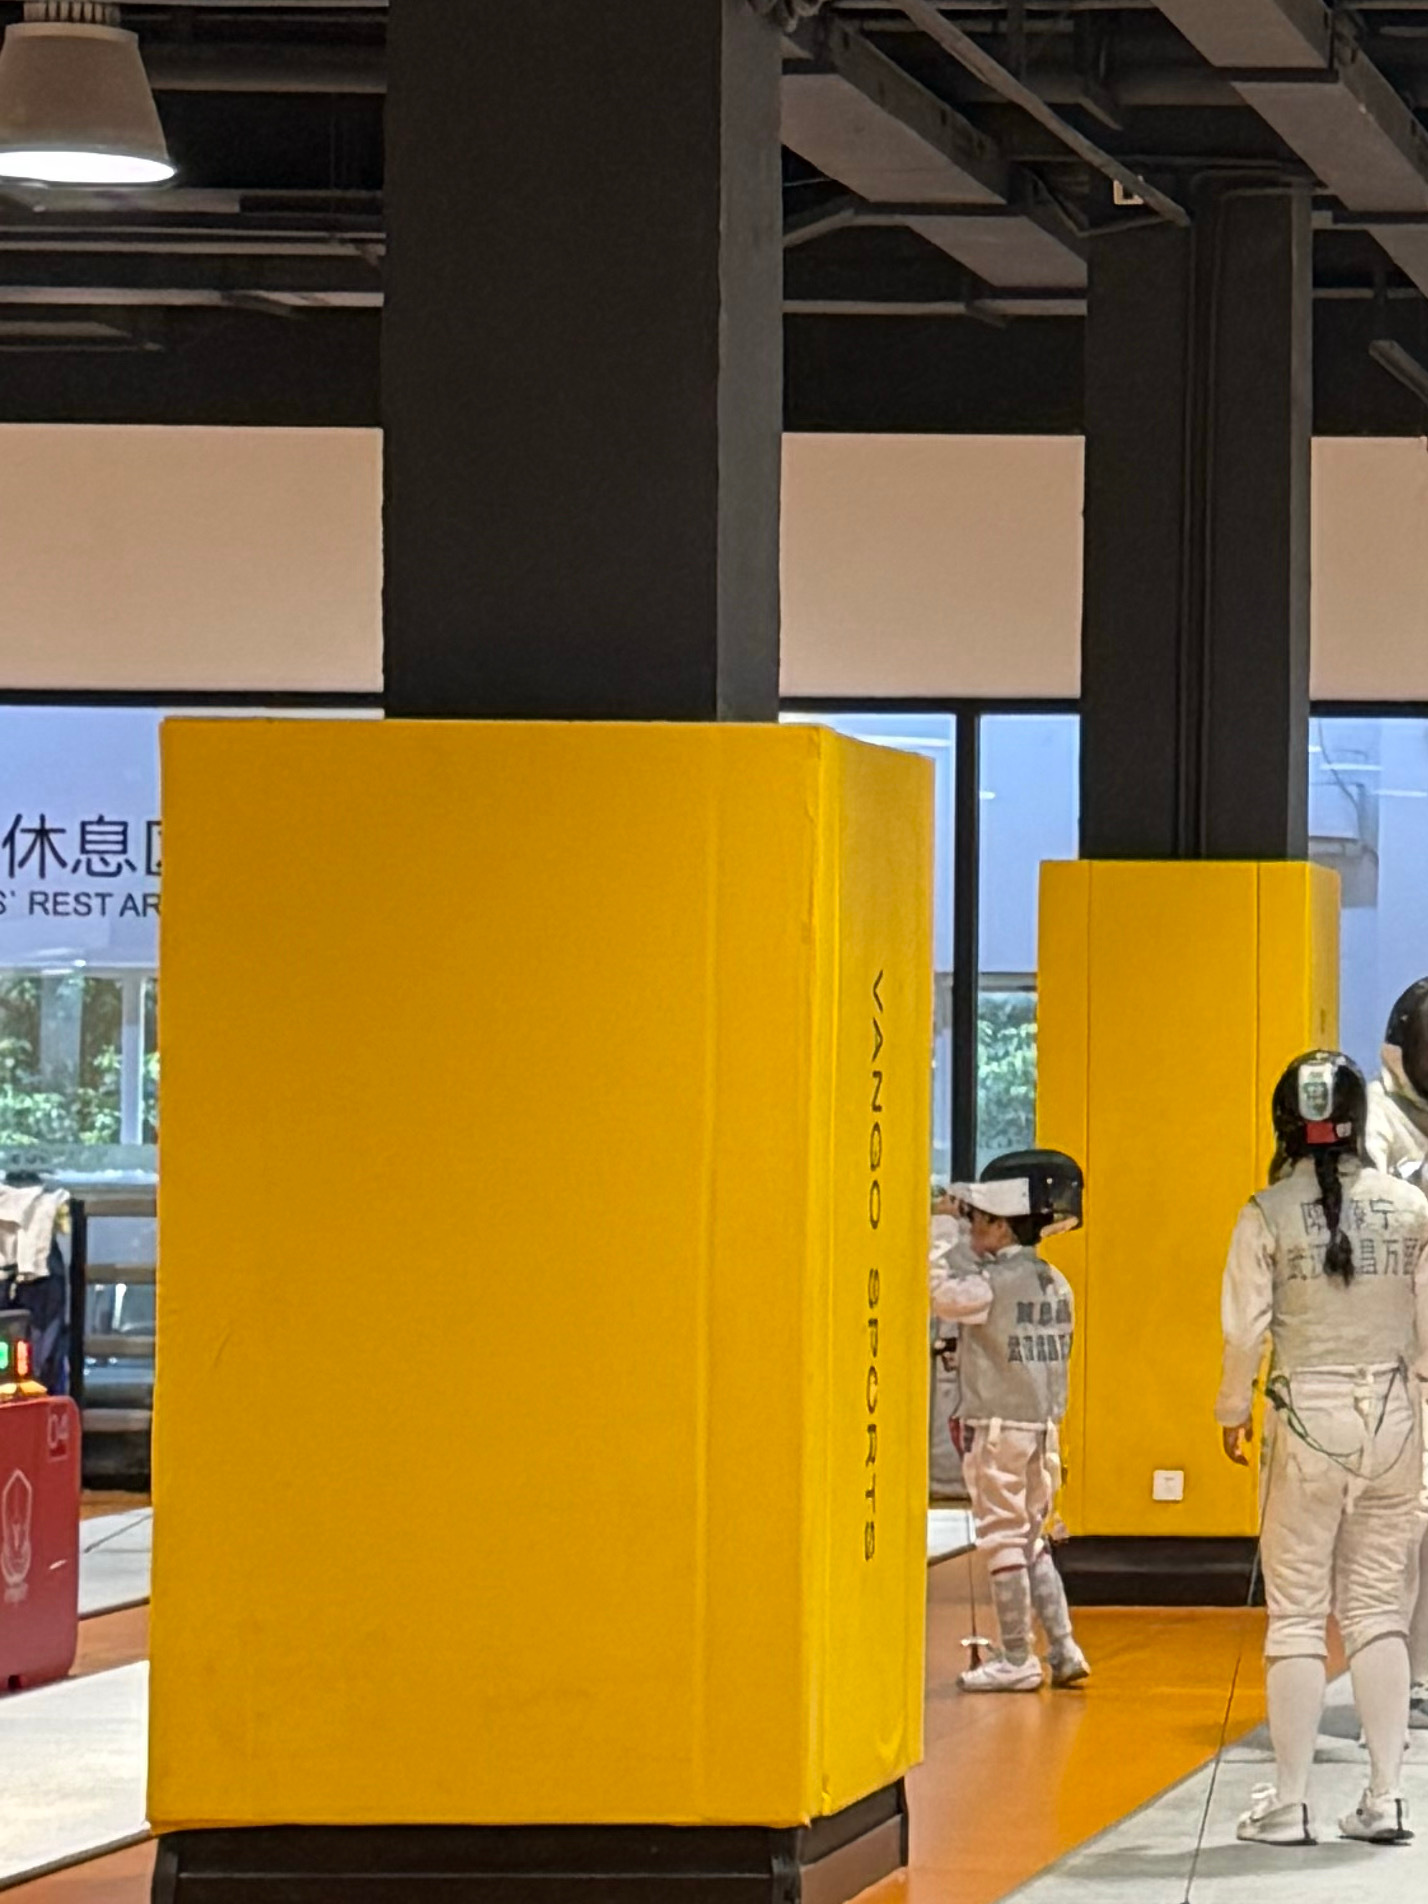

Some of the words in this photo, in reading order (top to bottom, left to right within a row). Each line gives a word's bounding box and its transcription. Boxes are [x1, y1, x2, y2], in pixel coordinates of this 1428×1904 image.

[2, 813, 162, 880] 休息
[28, 890, 114, 917] REST
[868, 969, 885, 1231] VANGO
[864, 1267, 881, 1562] SPORTS
